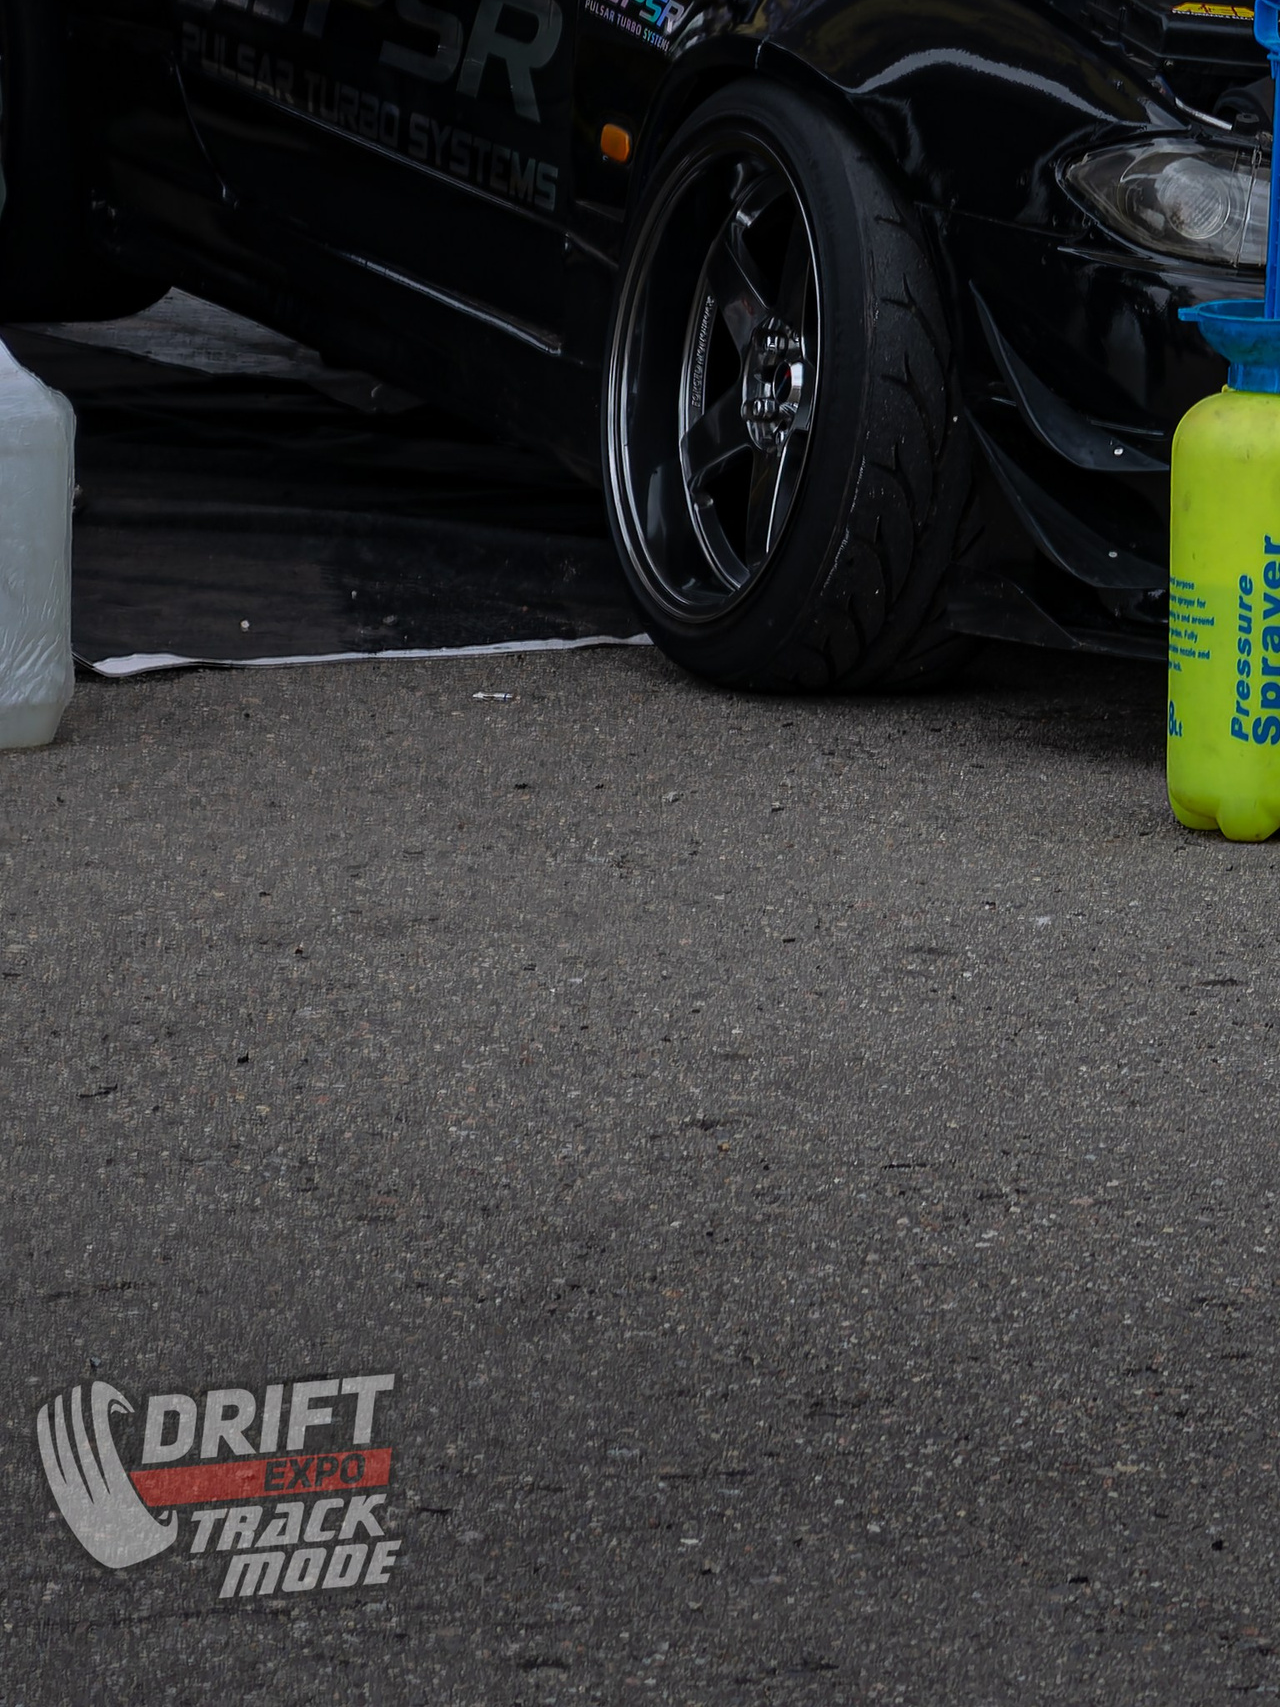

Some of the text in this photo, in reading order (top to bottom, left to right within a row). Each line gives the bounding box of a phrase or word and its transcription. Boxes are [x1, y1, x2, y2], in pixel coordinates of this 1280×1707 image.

[616, 12, 642, 38] TURBO
[181, 21, 560, 214] PULSAR TURBO SYSTEMS
[1191, 616, 1215, 627] around
[1198, 649, 1210, 660] and
[1231, 574, 1254, 743] Pressure
